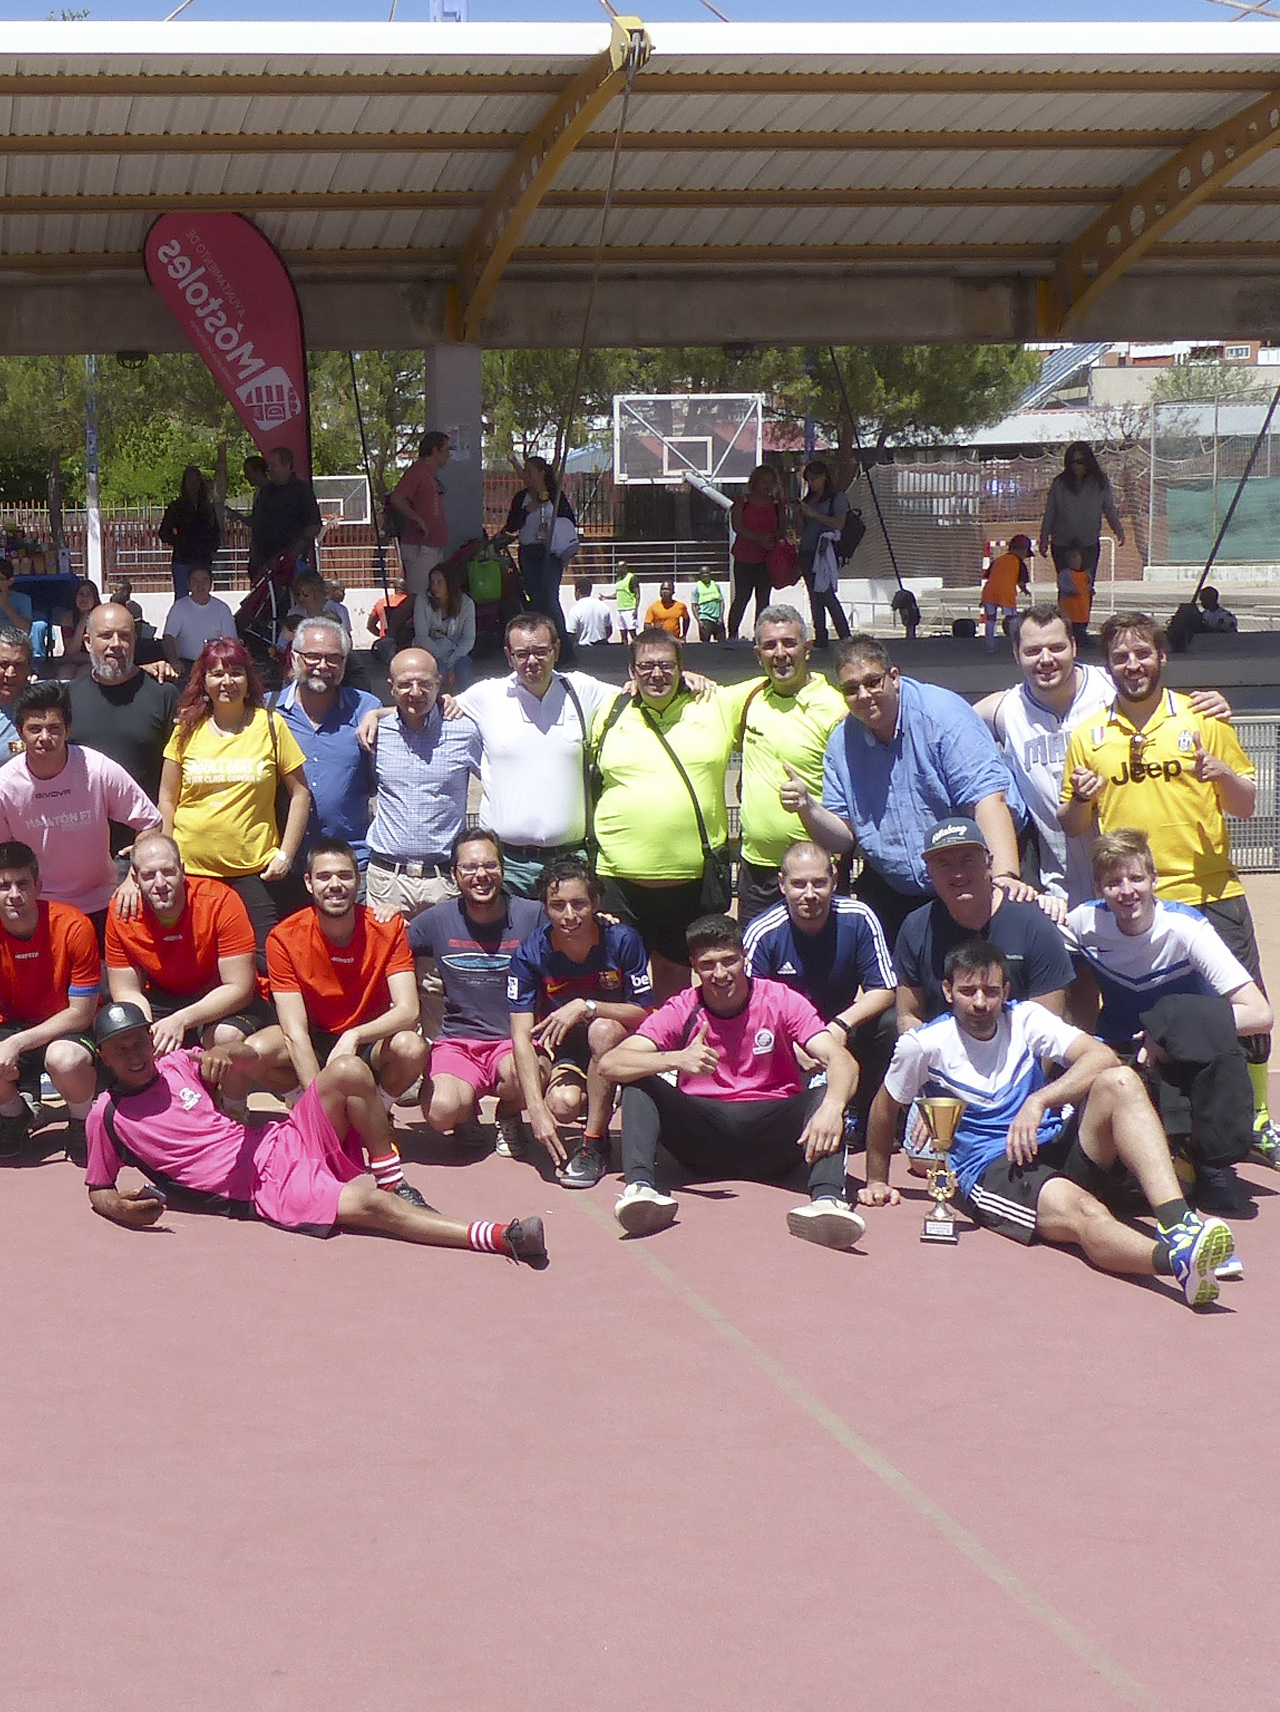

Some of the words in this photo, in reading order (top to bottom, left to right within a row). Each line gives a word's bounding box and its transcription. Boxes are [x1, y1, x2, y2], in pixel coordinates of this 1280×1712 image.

[1024, 731, 1072, 772] MA
[1111, 759, 1182, 787] Jeep
[35, 788, 71, 799] GIVOVA
